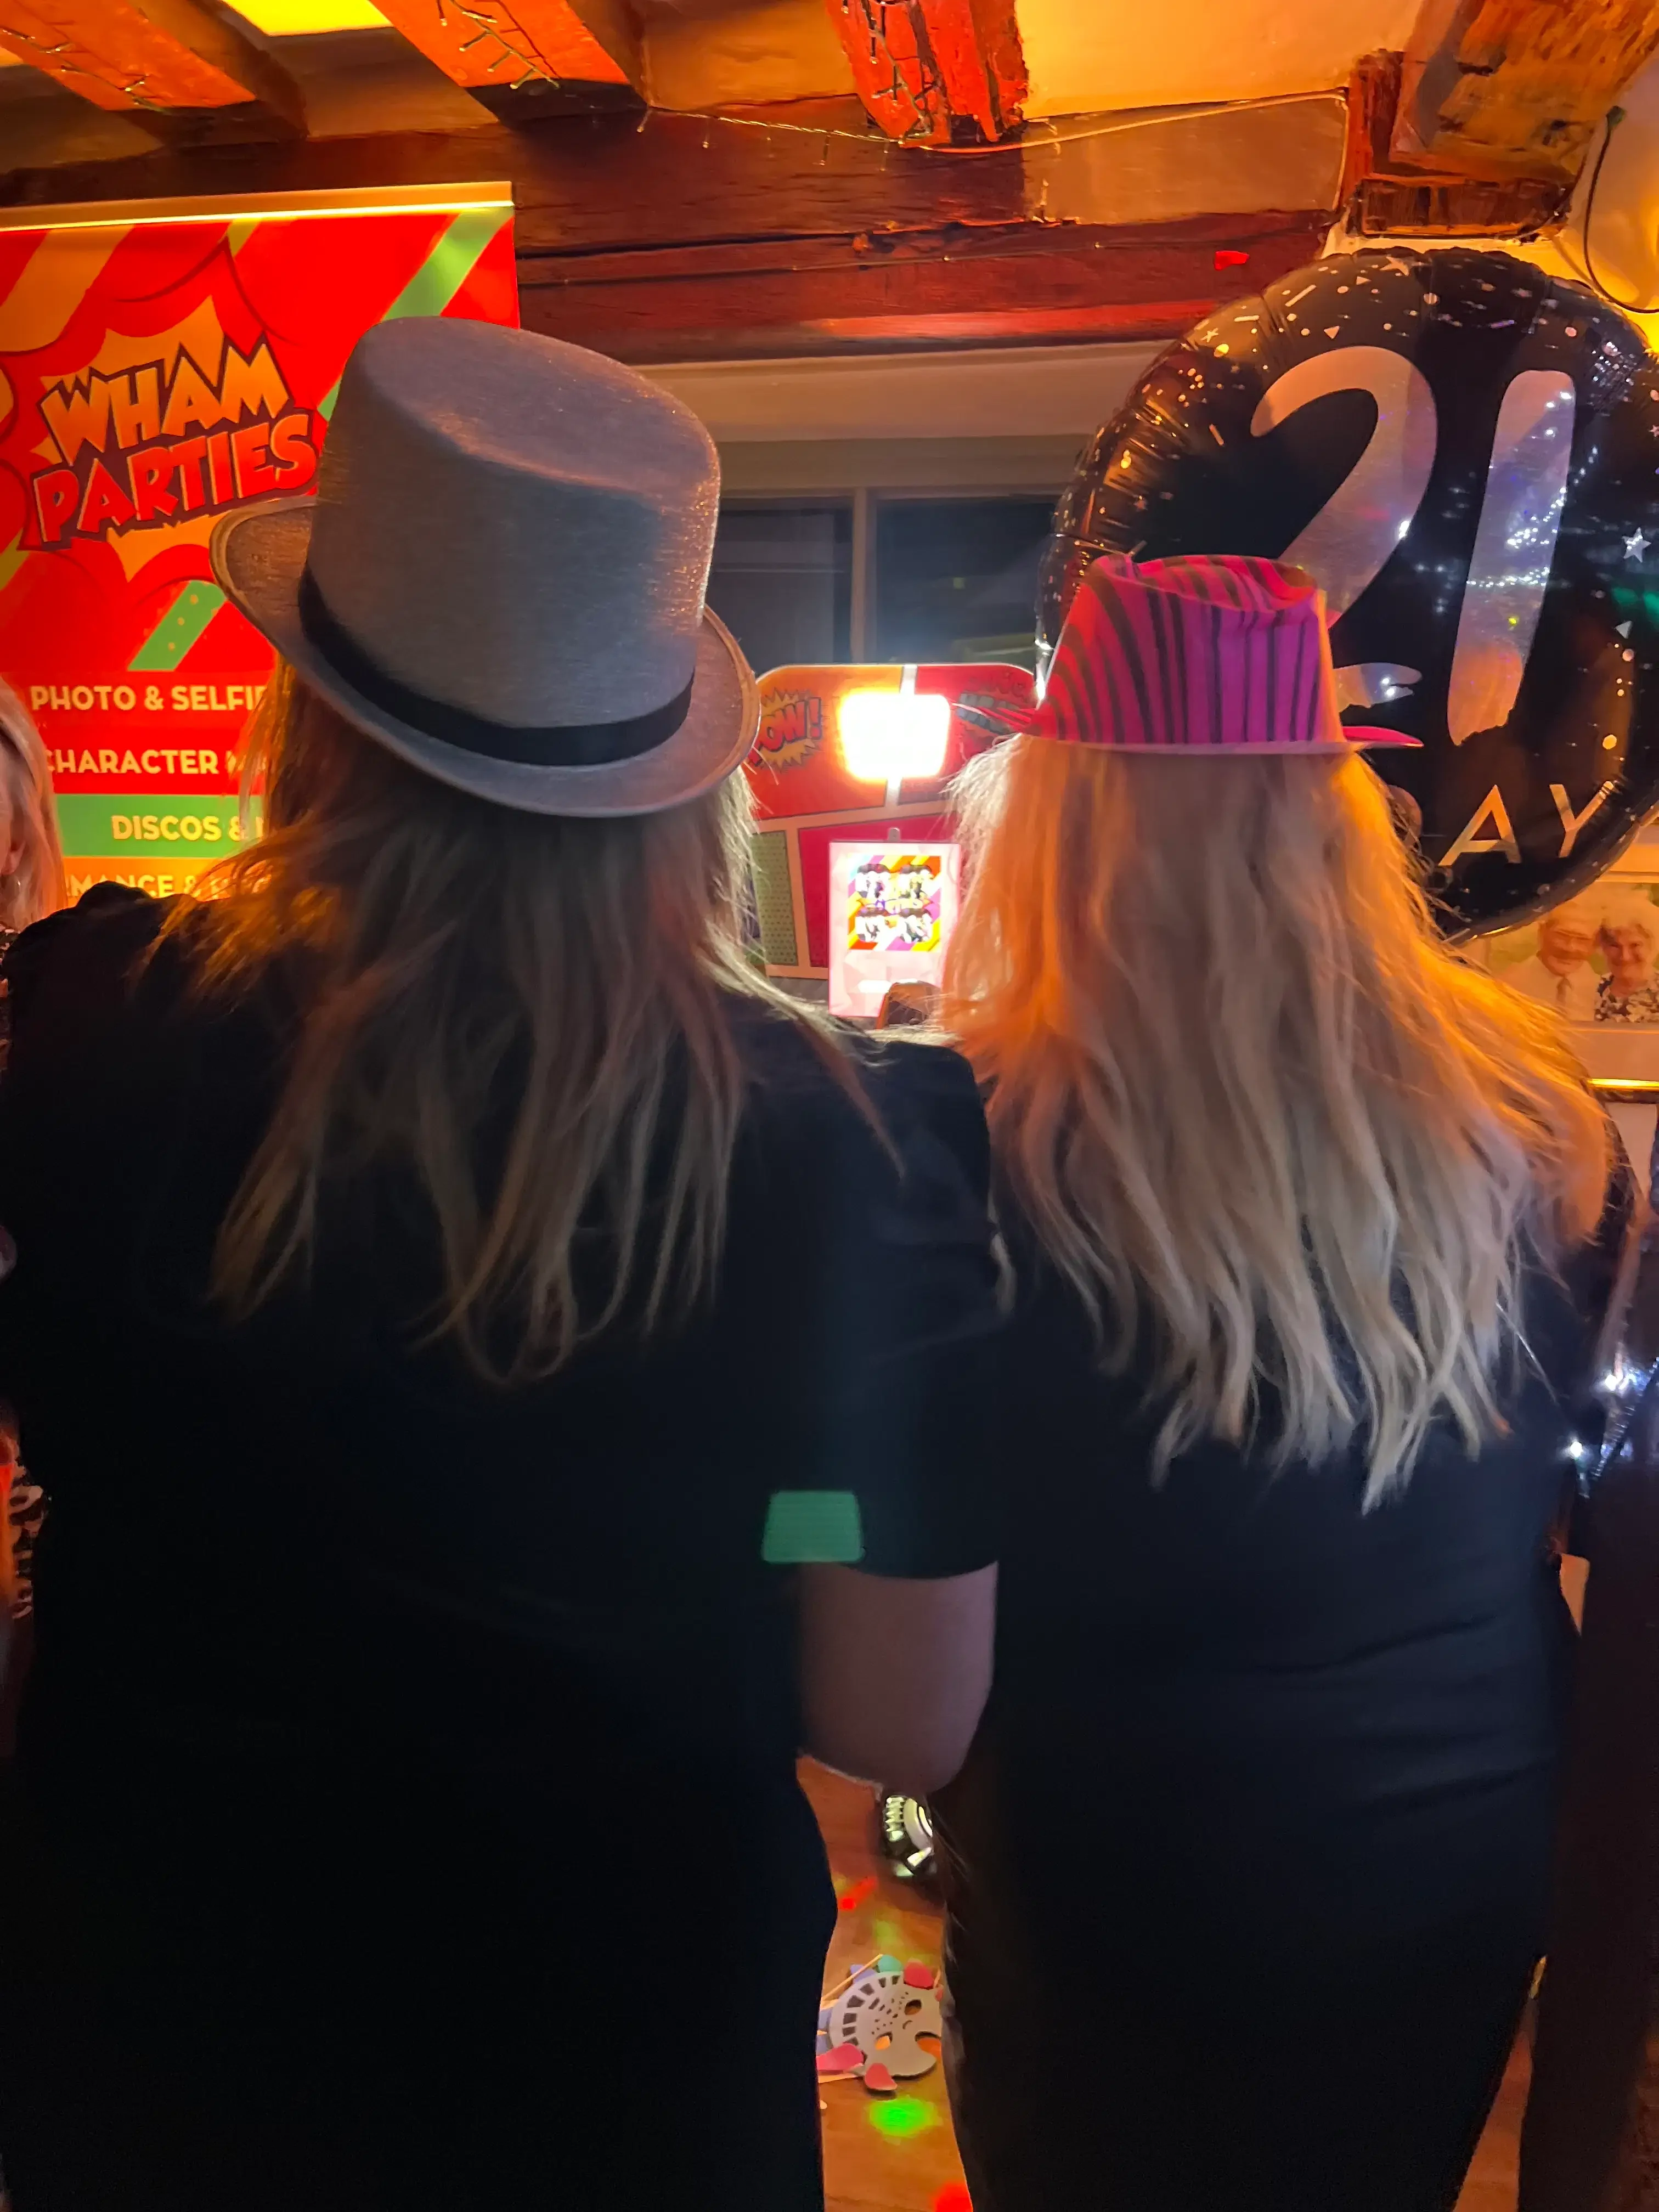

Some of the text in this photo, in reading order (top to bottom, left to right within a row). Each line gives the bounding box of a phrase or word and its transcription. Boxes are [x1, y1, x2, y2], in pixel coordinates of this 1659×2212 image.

[38, 336, 292, 467] WHAM
[32, 413, 317, 542] PARTIES
[1250, 346, 1576, 744] 21
[30, 685, 136, 710] PHOTO
[144, 686, 164, 710] &
[747, 697, 821, 765] OW!
[112, 815, 221, 840] DISCOS
[1391, 782, 1615, 866] AY
